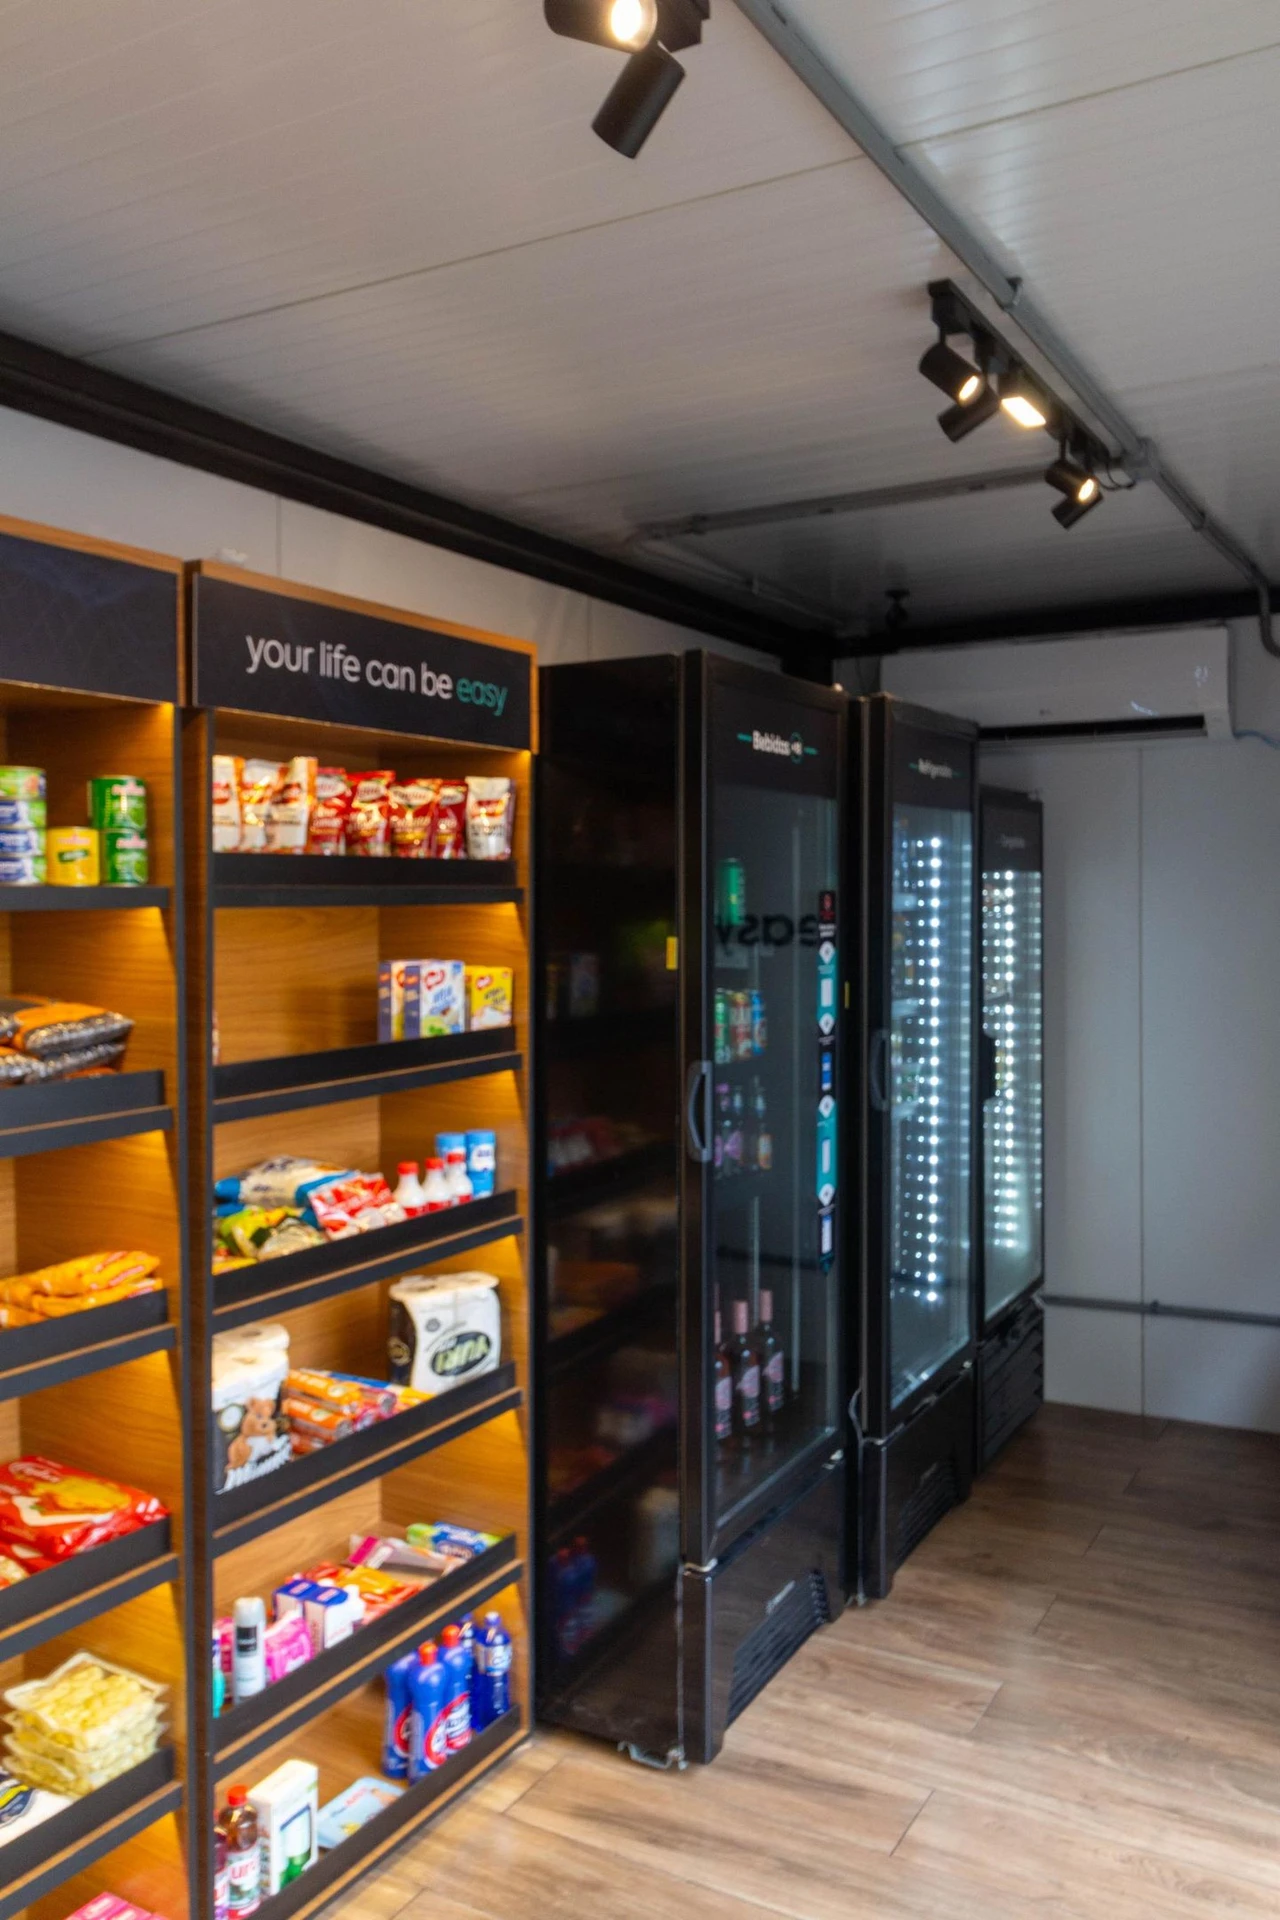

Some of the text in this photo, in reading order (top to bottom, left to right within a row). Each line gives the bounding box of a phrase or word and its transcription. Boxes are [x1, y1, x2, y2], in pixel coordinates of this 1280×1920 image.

[245, 635, 508, 716] your life can be easy
